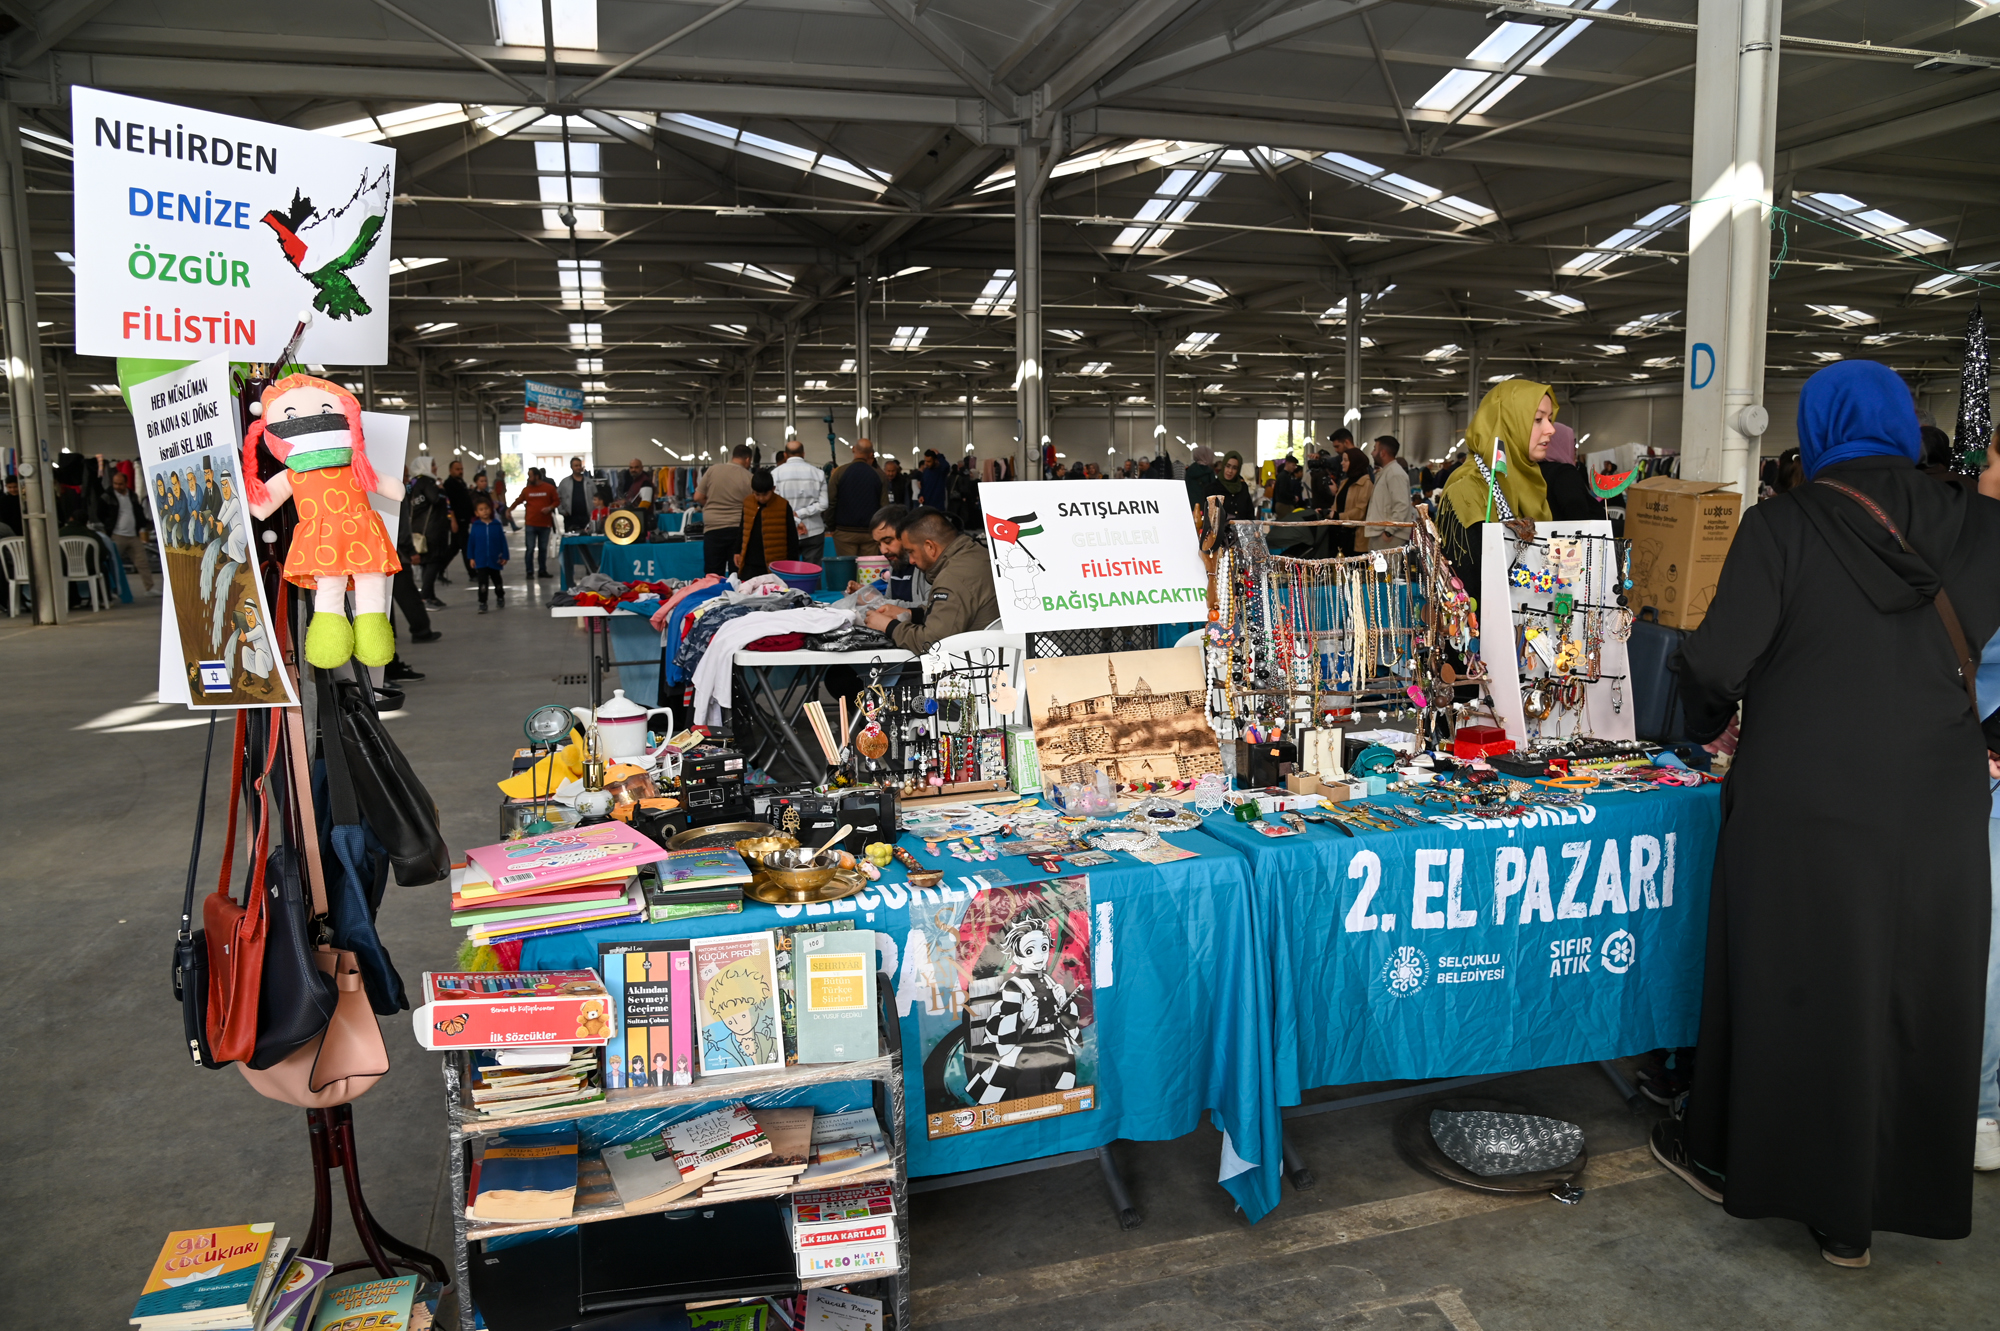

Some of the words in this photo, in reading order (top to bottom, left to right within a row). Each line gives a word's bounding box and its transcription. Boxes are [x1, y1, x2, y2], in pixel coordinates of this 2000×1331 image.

[95, 116, 277, 175] NEHİRDEN
[128, 186, 251, 230] DENİZE
[128, 243, 251, 288] ÖZGÜR
[122, 305, 256, 346] FİLİSTİN
[1690, 342, 1715, 390] D
[151, 392, 166, 411] HER
[168, 376, 208, 406] MÜSLÜMAN
[146, 420, 160, 439] BİR
[160, 414, 180, 434] KOVA
[181, 410, 192, 428] SU
[192, 401, 219, 424] DÖKSE
[180, 436, 195, 455] SEL
[196, 431, 213, 450] ALIR
[1057, 500, 1160, 519] SATIŞLARIN
[1072, 526, 1159, 547] GELİRLERİ
[1081, 557, 1163, 578] FİLİSTİNE
[1042, 586, 1208, 612] BAĞIŞLANACAKTIR
[1345, 849, 1396, 933] 2.
[1411, 848, 1478, 929] EL
[1492, 831, 1678, 926] PAZARI
[698, 951, 729, 963] KÜÇÜK
[731, 948, 761, 958] PRENS
[1550, 936, 1592, 957] SIFIR
[1438, 953, 1501, 969] SELÇUKLU
[1549, 954, 1591, 978] ATIK
[823, 977, 850, 985] Bütün
[1437, 966, 1505, 984] BELEDİYESİ
[627, 986, 669, 995] Aklından
[822, 985, 852, 994] Türkçe
[822, 994, 852, 1004] Şiirleri
[627, 995, 669, 1005] Sevmeyi
[628, 1005, 669, 1014] Geçirme
[505, 1031, 557, 1043] Sözcükler
[692, 1125, 731, 1142] KARAY
[816, 1233, 839, 1243] ZEKA
[841, 1227, 886, 1240] KARTLARI
[854, 1251, 885, 1259] HAFIZA
[854, 1257, 886, 1267] KARTI
[329, 1285, 364, 1300] YATILI
[364, 1279, 410, 1291] OKULDA
[336, 1287, 399, 1306] MÜKEMMEL
[344, 1300, 362, 1311] BİR
[365, 1296, 389, 1306] GÜN
